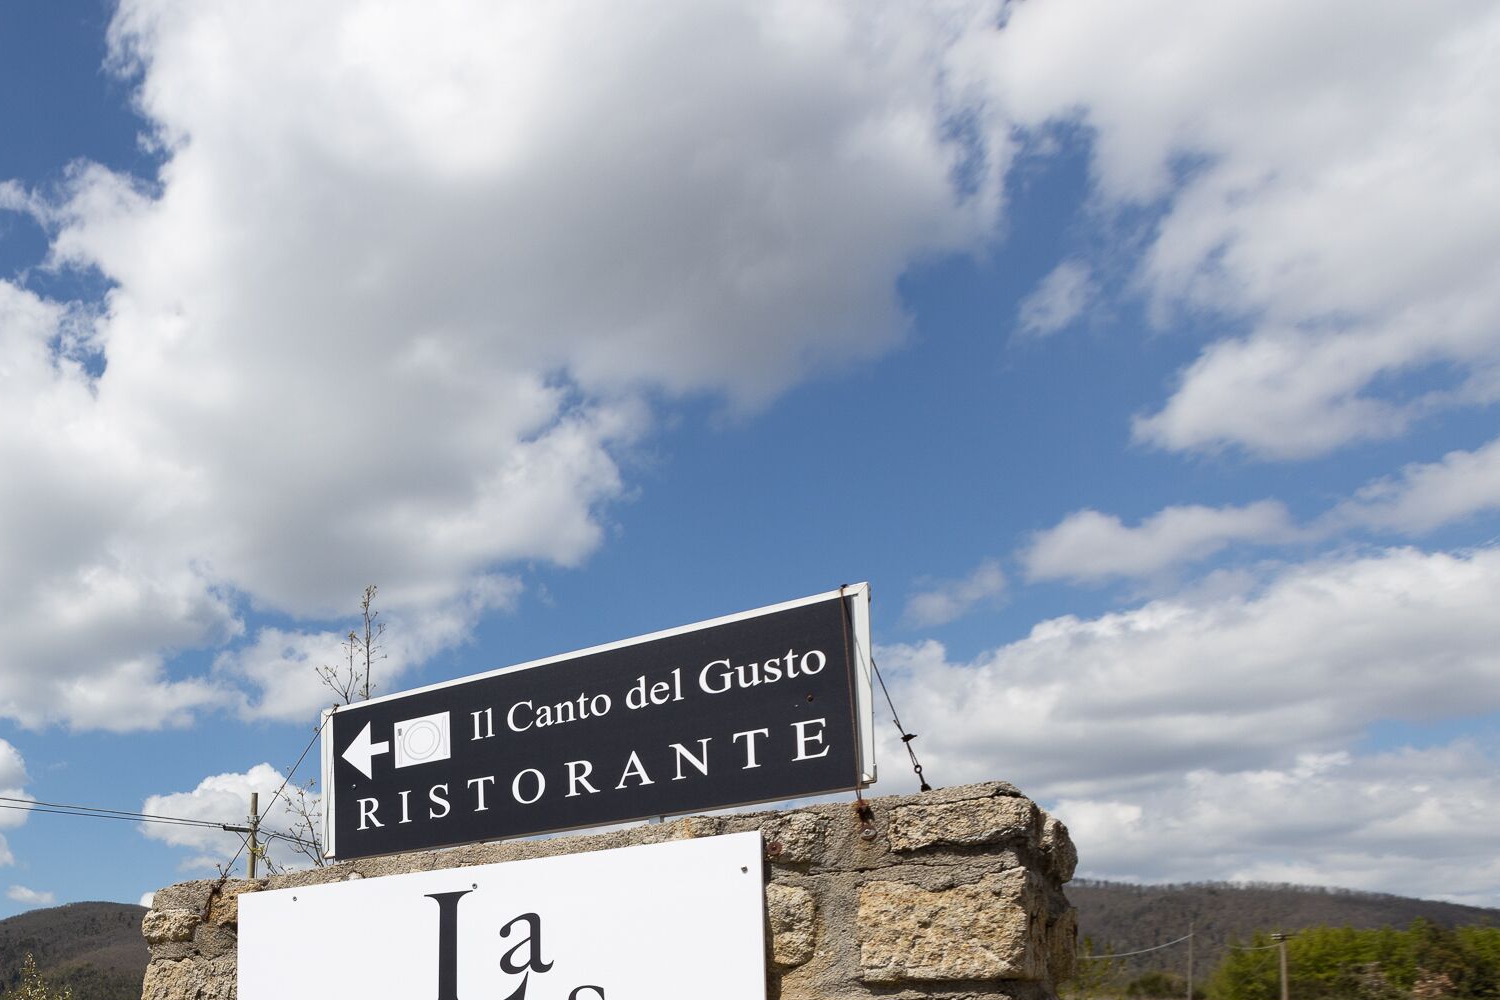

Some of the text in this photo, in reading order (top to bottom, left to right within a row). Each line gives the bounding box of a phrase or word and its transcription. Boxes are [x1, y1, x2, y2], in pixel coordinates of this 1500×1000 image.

[470, 649, 828, 741] Il Canto del Gusto
[356, 717, 831, 831] RISTORANTE
